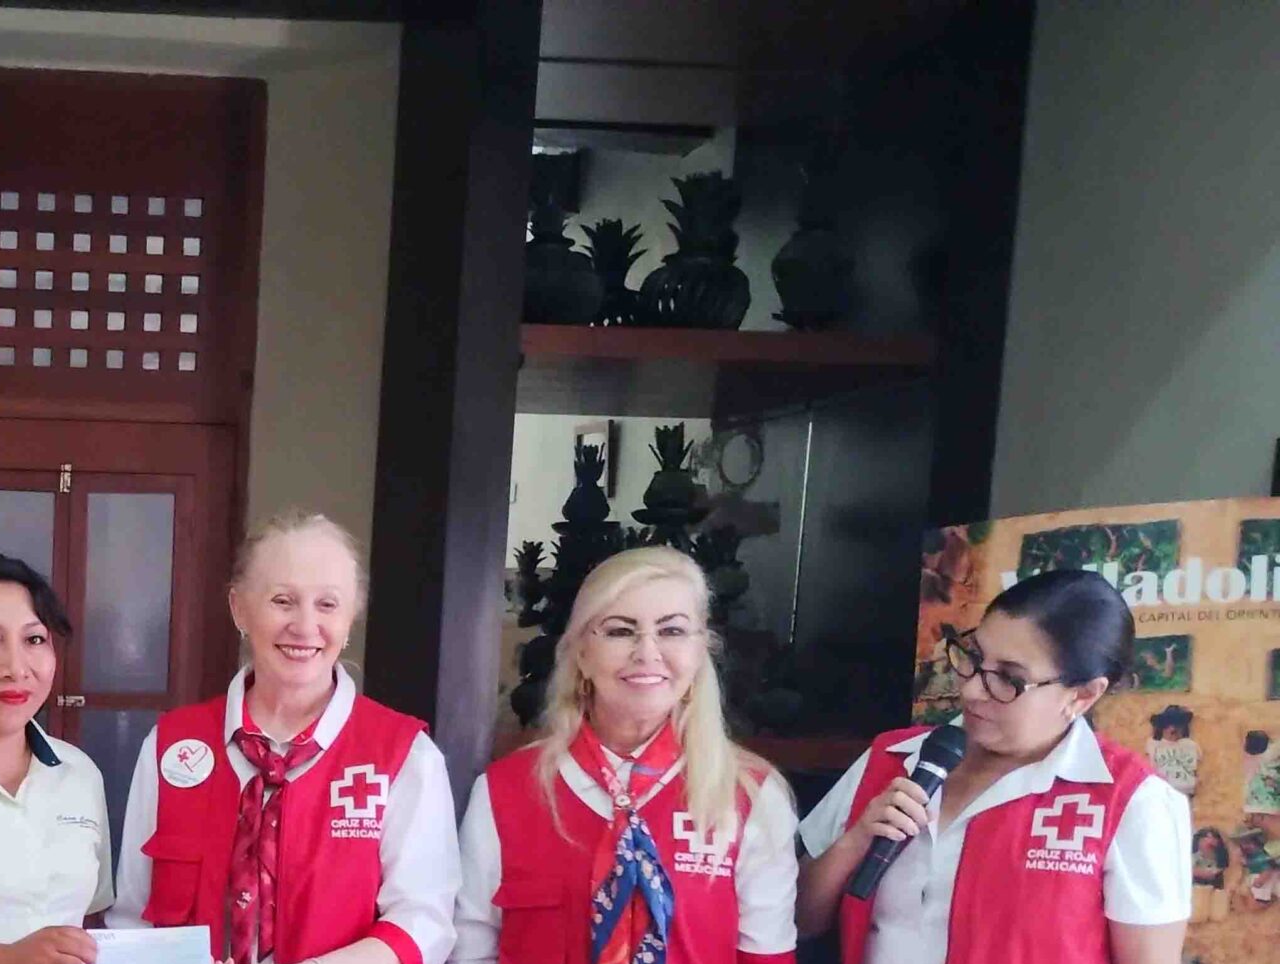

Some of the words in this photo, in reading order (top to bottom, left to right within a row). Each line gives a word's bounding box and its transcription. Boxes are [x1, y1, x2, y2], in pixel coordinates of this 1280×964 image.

[1138, 610, 1191, 623] CAPITAL
[331, 819, 360, 828] CRUZ
[1027, 849, 1061, 860] CRUZ
[1065, 851, 1097, 864] ROJA
[1025, 859, 1094, 875] MEXICANA
